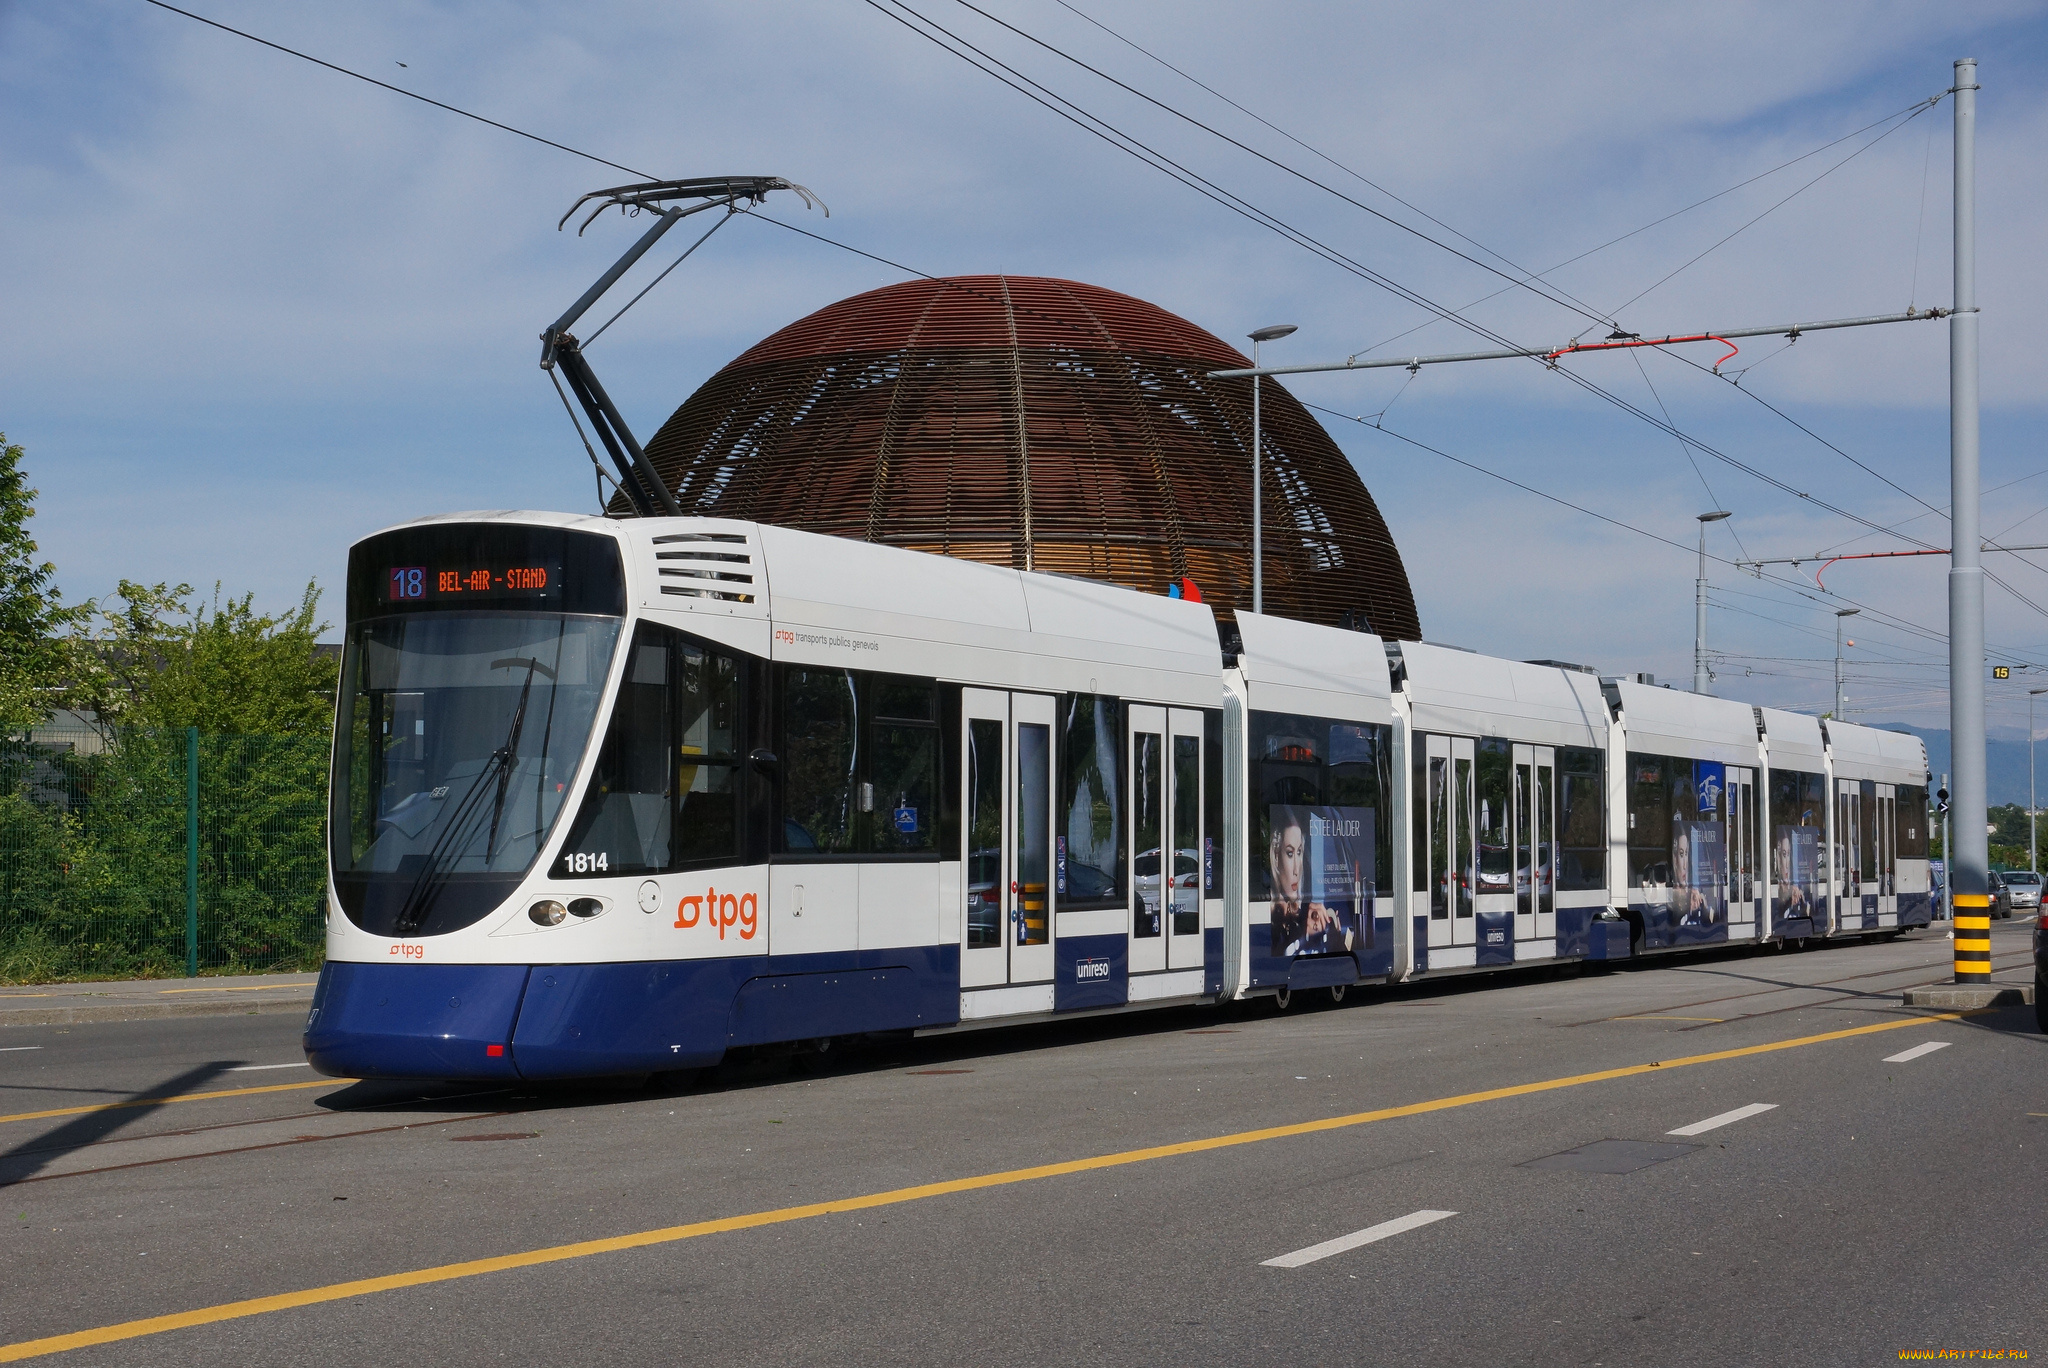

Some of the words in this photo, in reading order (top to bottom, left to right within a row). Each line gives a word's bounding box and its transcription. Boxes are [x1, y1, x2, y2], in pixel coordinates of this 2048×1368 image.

[393, 569, 423, 598] 18
[438, 570, 491, 592] BEL-AIR
[507, 568, 547, 589] STAND
[795, 632, 828, 646] transports
[828, 635, 851, 648] publics
[852, 640, 879, 651] genevois
[1994, 667, 2008, 678] 15
[1332, 820, 1360, 837] LAUDER
[564, 852, 608, 873] 1814
[1077, 960, 1109, 978] unireso
